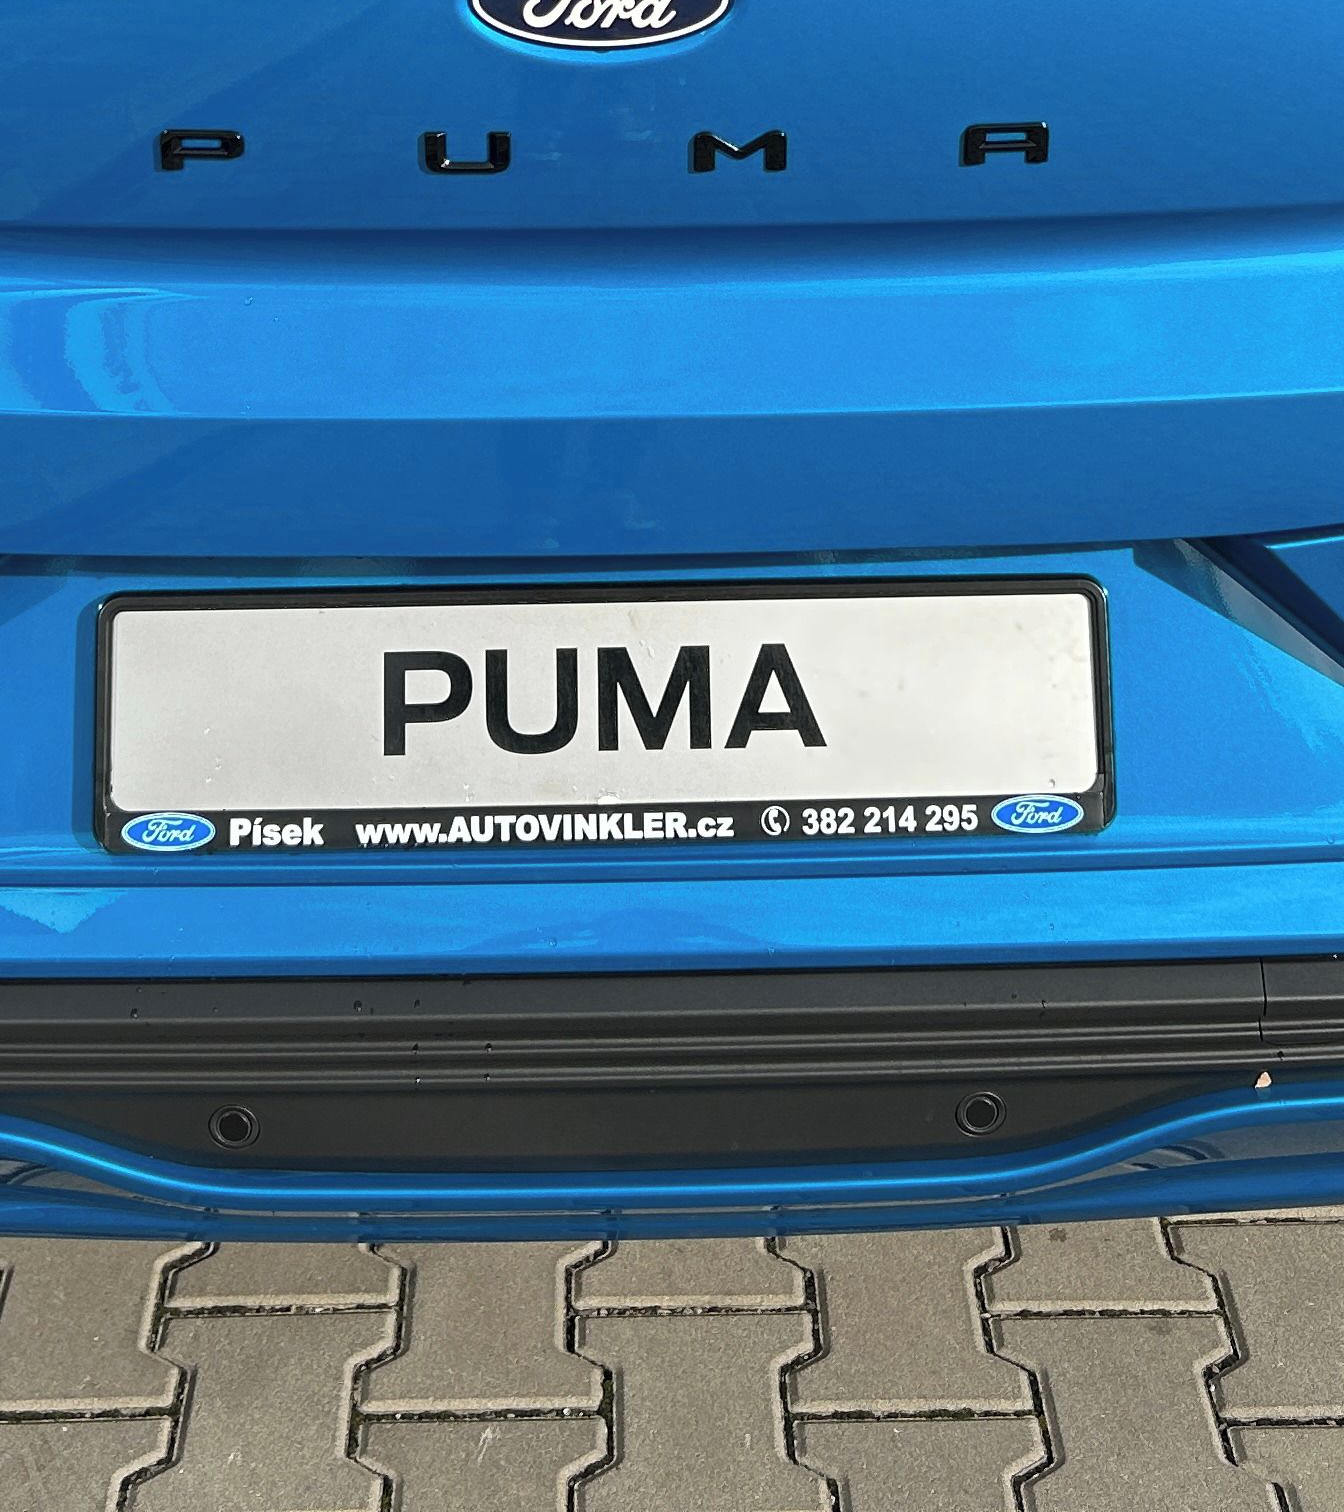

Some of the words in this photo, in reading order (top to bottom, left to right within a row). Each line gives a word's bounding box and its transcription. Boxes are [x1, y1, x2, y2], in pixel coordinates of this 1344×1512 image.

[154, 120, 1050, 173] PUMA
[383, 643, 828, 757] PUMA
[229, 816, 325, 846] Písek
[355, 812, 735, 845] www.AUTOVINKLER.cz
[802, 807, 856, 836] 382
[863, 805, 917, 833] 214
[925, 803, 979, 831] 295
